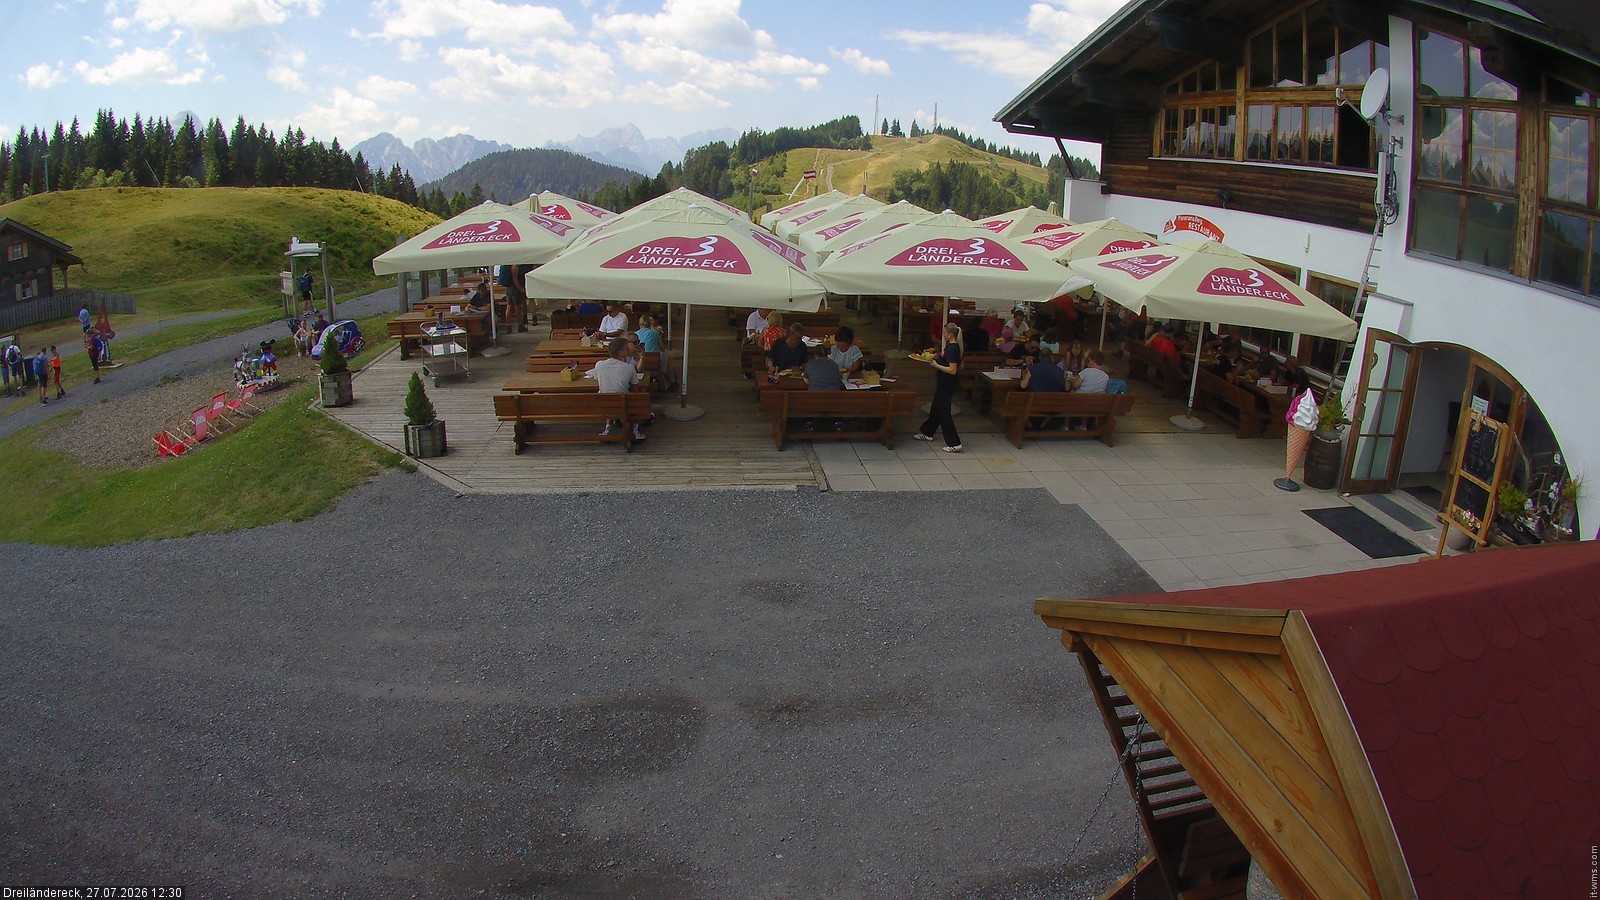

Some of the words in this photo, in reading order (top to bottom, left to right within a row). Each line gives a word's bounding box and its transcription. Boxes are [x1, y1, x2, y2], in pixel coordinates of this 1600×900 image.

[447, 230, 476, 239] DREI.
[1187, 221, 1221, 241] RESTAURANT
[438, 233, 513, 245] LÄNDER.ECK
[638, 245, 681, 256] DREI.
[915, 246, 957, 255] DREI.
[626, 254, 738, 269] LÄNDER.ECK
[908, 253, 1012, 266] LÄNDER.ECK
[1211, 274, 1245, 286] DREI.
[1210, 282, 1290, 300] LÄNDER.ECK
